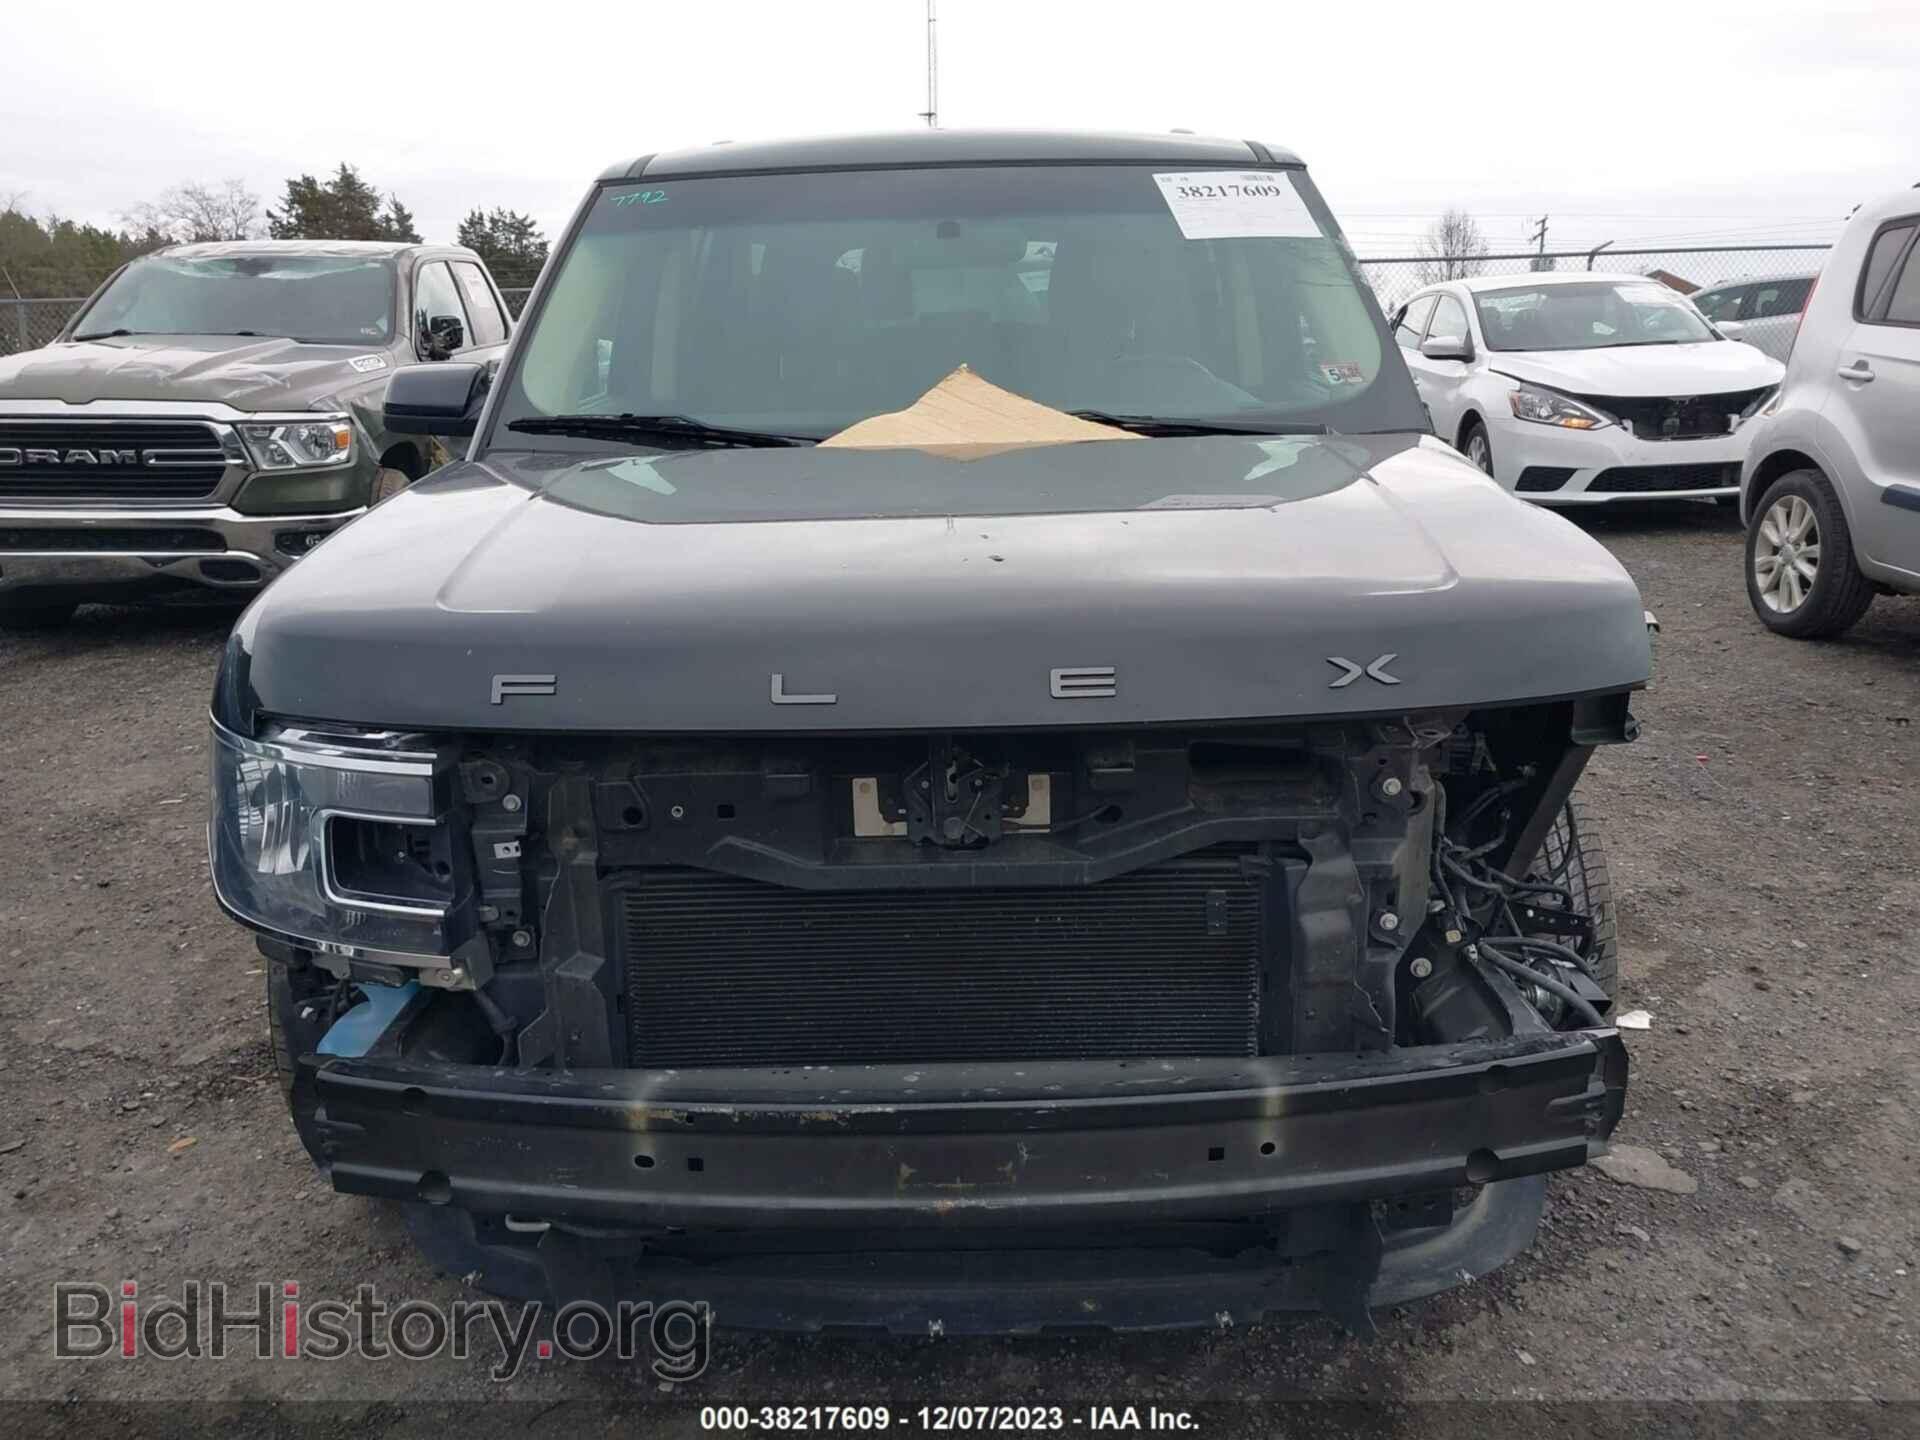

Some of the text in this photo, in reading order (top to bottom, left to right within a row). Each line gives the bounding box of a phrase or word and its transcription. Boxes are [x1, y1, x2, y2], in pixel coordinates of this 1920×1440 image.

[1176, 184, 1281, 198] 38217609
[1329, 368, 1341, 382] 5
[24, 448, 137, 465] RAM
[490, 653, 1401, 705] FLEX
